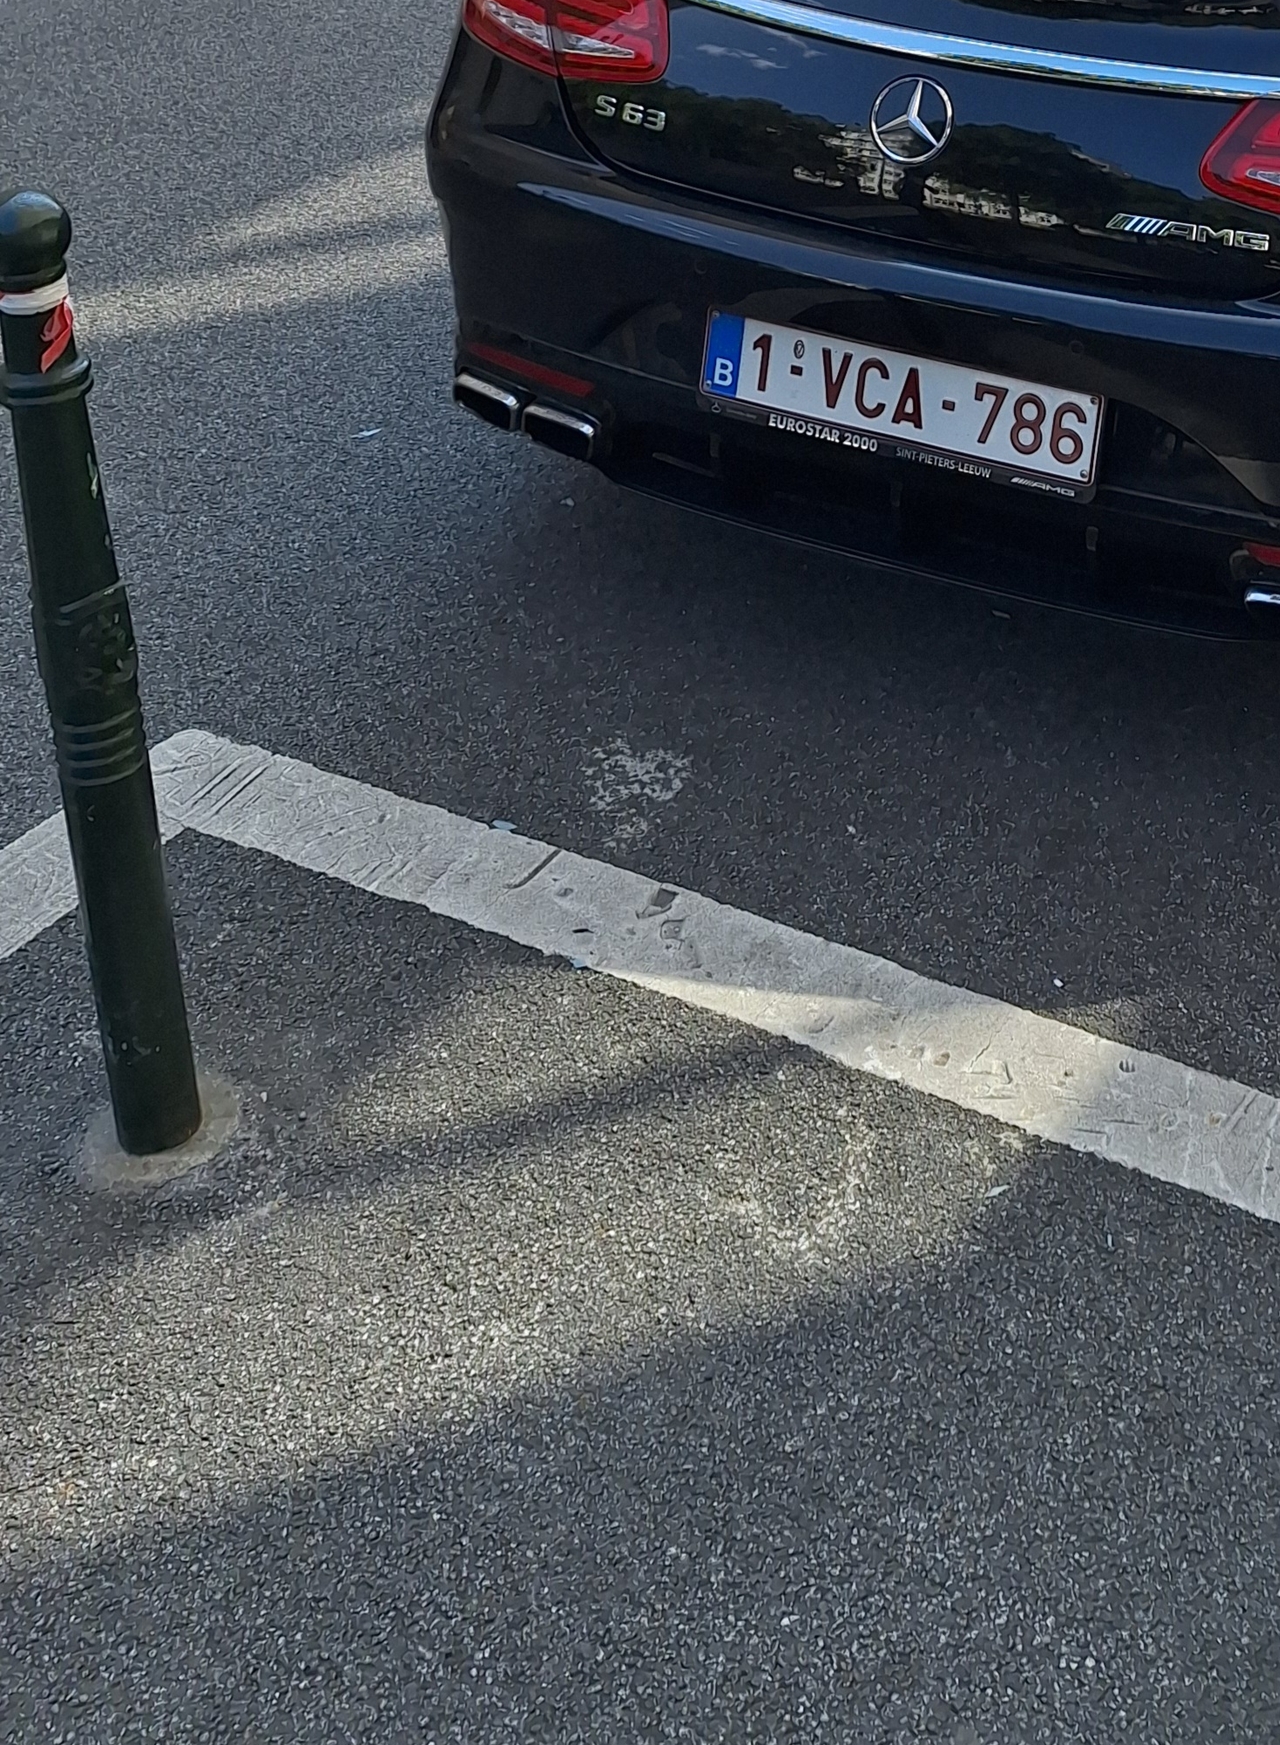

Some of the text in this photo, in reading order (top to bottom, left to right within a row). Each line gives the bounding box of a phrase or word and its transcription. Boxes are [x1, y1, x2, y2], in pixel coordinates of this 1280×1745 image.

[594, 94, 666, 132] S 63
[1154, 219, 1270, 251] AMG
[713, 333, 1088, 465] B 1-VCA-786
[767, 413, 840, 443] EUROSTAR
[842, 432, 878, 452] 2000
[895, 446, 993, 479] SINT-PIETERS-LEEUW
